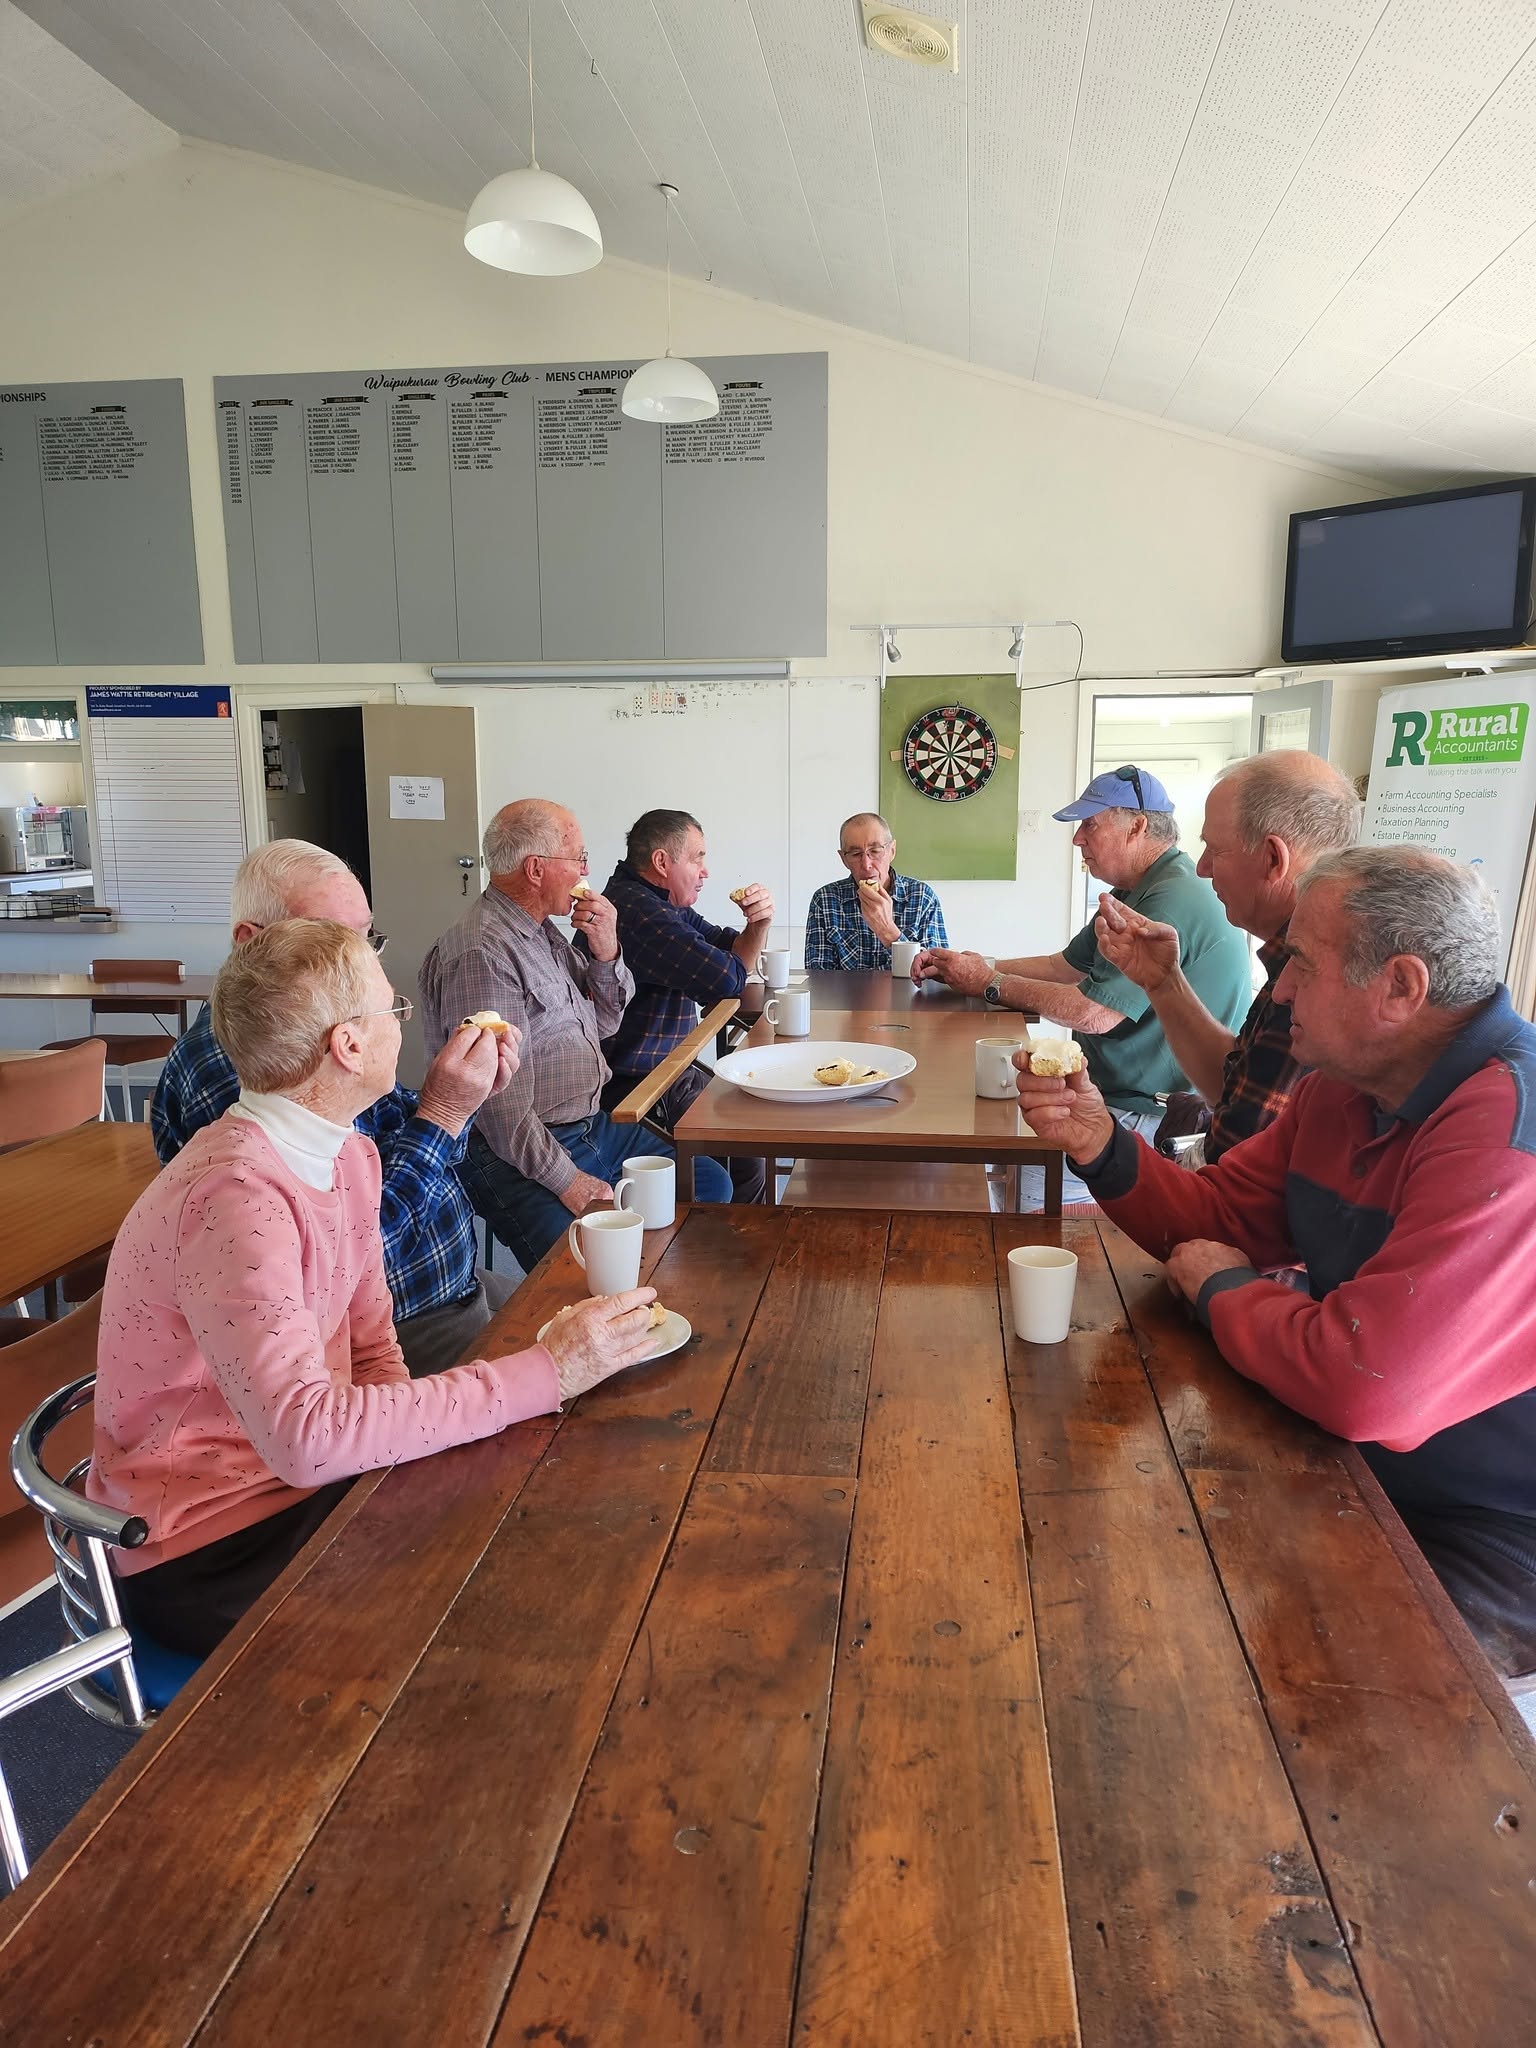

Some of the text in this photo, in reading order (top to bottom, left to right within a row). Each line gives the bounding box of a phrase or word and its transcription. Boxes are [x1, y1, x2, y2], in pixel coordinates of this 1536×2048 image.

[364, 374, 439, 391] Waipukurau
[444, 373, 497, 389] Bowling
[502, 371, 532, 385] Club
[546, 372, 575, 382] MENS
[0, 392, 47, 402] IONSHIPS
[173, 691, 199, 699] VILLAGE
[1437, 707, 1519, 739] Rural
[1385, 711, 1427, 767] R
[1434, 738, 1518, 754] Accountants
[1428, 768, 1455, 777] Walking
[1470, 767, 1483, 775] talk
[1484, 766, 1500, 774] with
[1501, 766, 1517, 776] you
[1385, 789, 1498, 801] Farm Accounting Specialists
[1383, 803, 1465, 815] Business Accounting
[1381, 817, 1449, 829] Taxation Planning
[1378, 831, 1437, 842] Estate Planning
